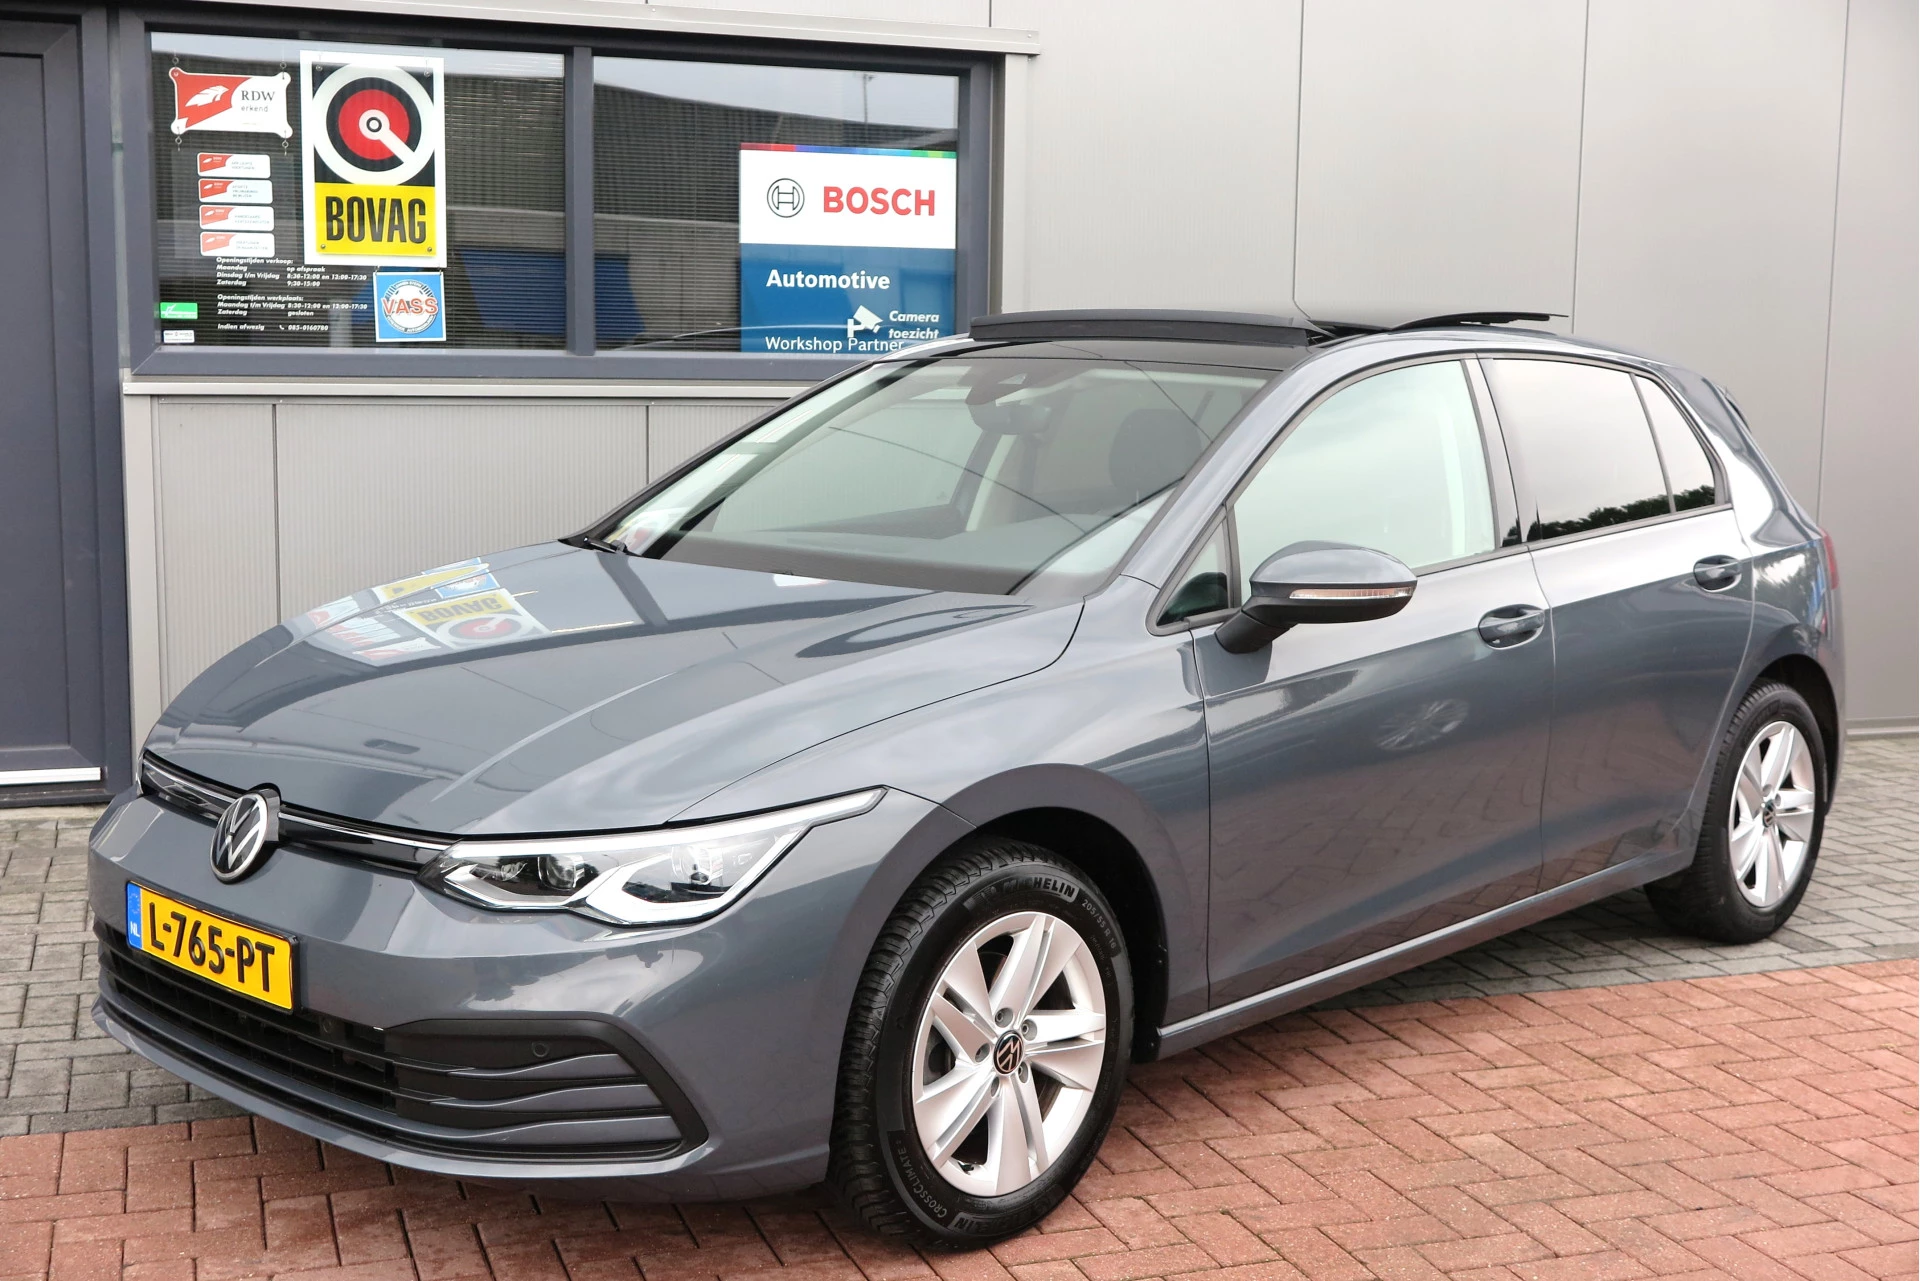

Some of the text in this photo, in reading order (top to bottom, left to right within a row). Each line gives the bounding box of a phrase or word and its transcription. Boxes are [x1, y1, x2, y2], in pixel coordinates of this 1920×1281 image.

[241, 90, 276, 102] RDW
[823, 186, 936, 216] BOSCH
[324, 196, 427, 243] BOVAG
[216, 256, 294, 266] Openingstijden verkoop:
[766, 269, 890, 290] Automotive
[382, 298, 438, 315] VASS
[889, 310, 940, 323] Camera
[888, 328, 940, 340] toezicht
[765, 336, 904, 354] Workshop Partner
[130, 921, 140, 938] NL
[149, 902, 275, 992] L-765-PT
[897, 1146, 948, 1218] CROSSCLIMATE
